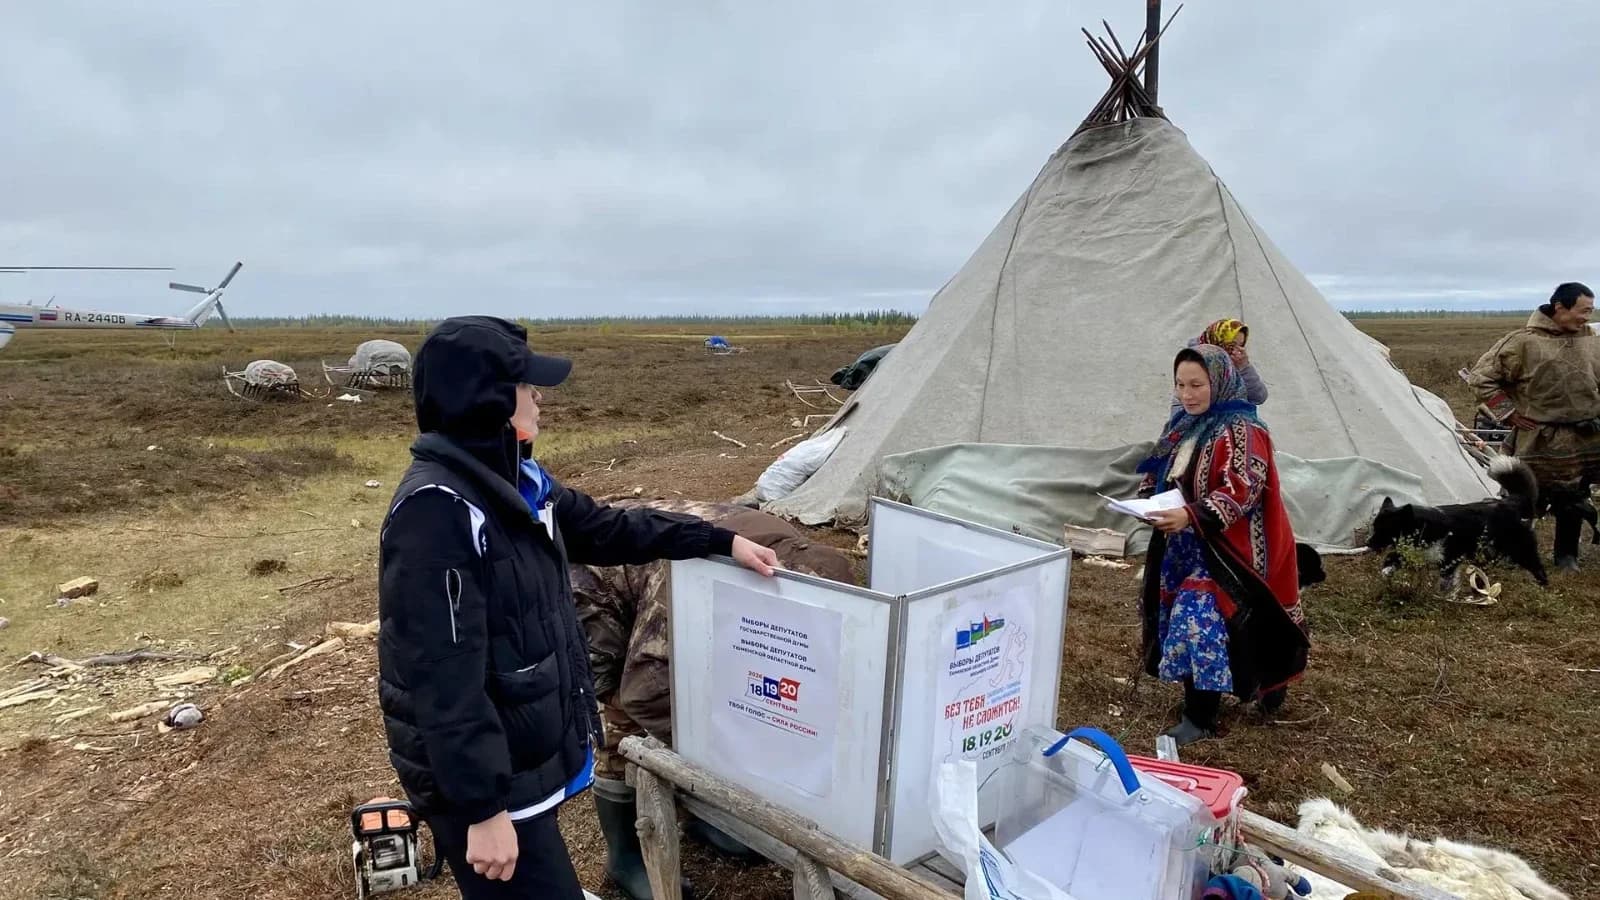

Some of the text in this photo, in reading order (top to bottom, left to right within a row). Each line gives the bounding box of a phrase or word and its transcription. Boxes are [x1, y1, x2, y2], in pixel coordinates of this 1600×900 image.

[65, 312, 126, 323] RA-24406
[739, 626, 809, 649] ГОСУДАРСТВЕННОЙ ДУМЫ
[741, 616, 808, 640] ВЫБОРЫ ДЕПУТАТОВ
[732, 645, 816, 673] ТЮМЕНСКОЙ ОБЛАСТНОЙ ДУМЫ
[740, 638, 807, 662] ВЫБОРЫ ДЕПУТАТОВ
[949, 646, 1000, 670] ВЫБОРЫ ДЕПУТАТОВ
[750, 682, 797, 696] 18 19 20
[765, 698, 798, 713] СЕНТЯБРЯ
[944, 700, 961, 720] БЕЗ
[963, 694, 986, 712] ТЕБЯ
[962, 714, 975, 731] НЕ
[976, 696, 1021, 726] СЛОЖИТСЯ!
[728, 700, 745, 712] ТВОЙ
[745, 706, 766, 719] ГОЛОС
[771, 716, 789, 727] СИЛА
[789, 722, 818, 737] РОССИИ!
[982, 742, 1005, 760] СЕНТЯБРЯ
